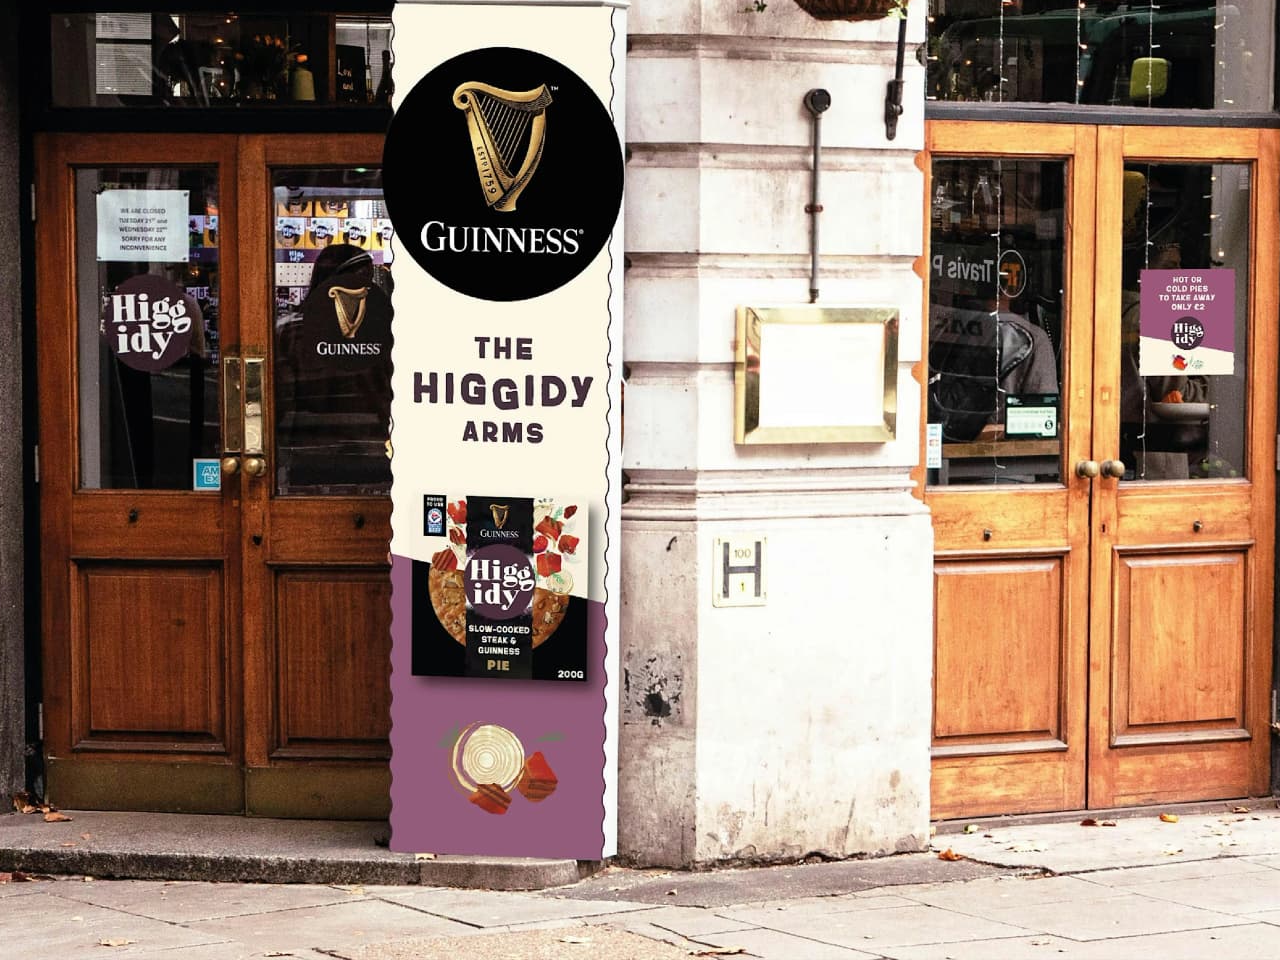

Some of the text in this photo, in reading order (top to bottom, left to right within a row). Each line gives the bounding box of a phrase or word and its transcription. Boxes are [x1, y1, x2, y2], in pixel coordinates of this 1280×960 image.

[420, 220, 584, 255] GUINNESS
[111, 293, 191, 334] Higg
[1174, 322, 1203, 337] Higg
[117, 324, 175, 360] idy
[1176, 334, 1196, 346] idy
[316, 341, 380, 356] GUINNESS
[474, 336, 533, 361] THE
[412, 371, 594, 411] HIGGIDY
[461, 420, 544, 444] ARMS
[480, 528, 519, 539] GUINNESS
[735, 548, 751, 558] 100
[470, 559, 535, 592] Higg
[473, 582, 521, 611] idy
[468, 624, 531, 635] SLOW-COOKED
[481, 635, 508, 645] STEAK
[478, 646, 521, 656] GUINNESS
[487, 660, 510, 671] PIE
[557, 670, 584, 679] 200G
